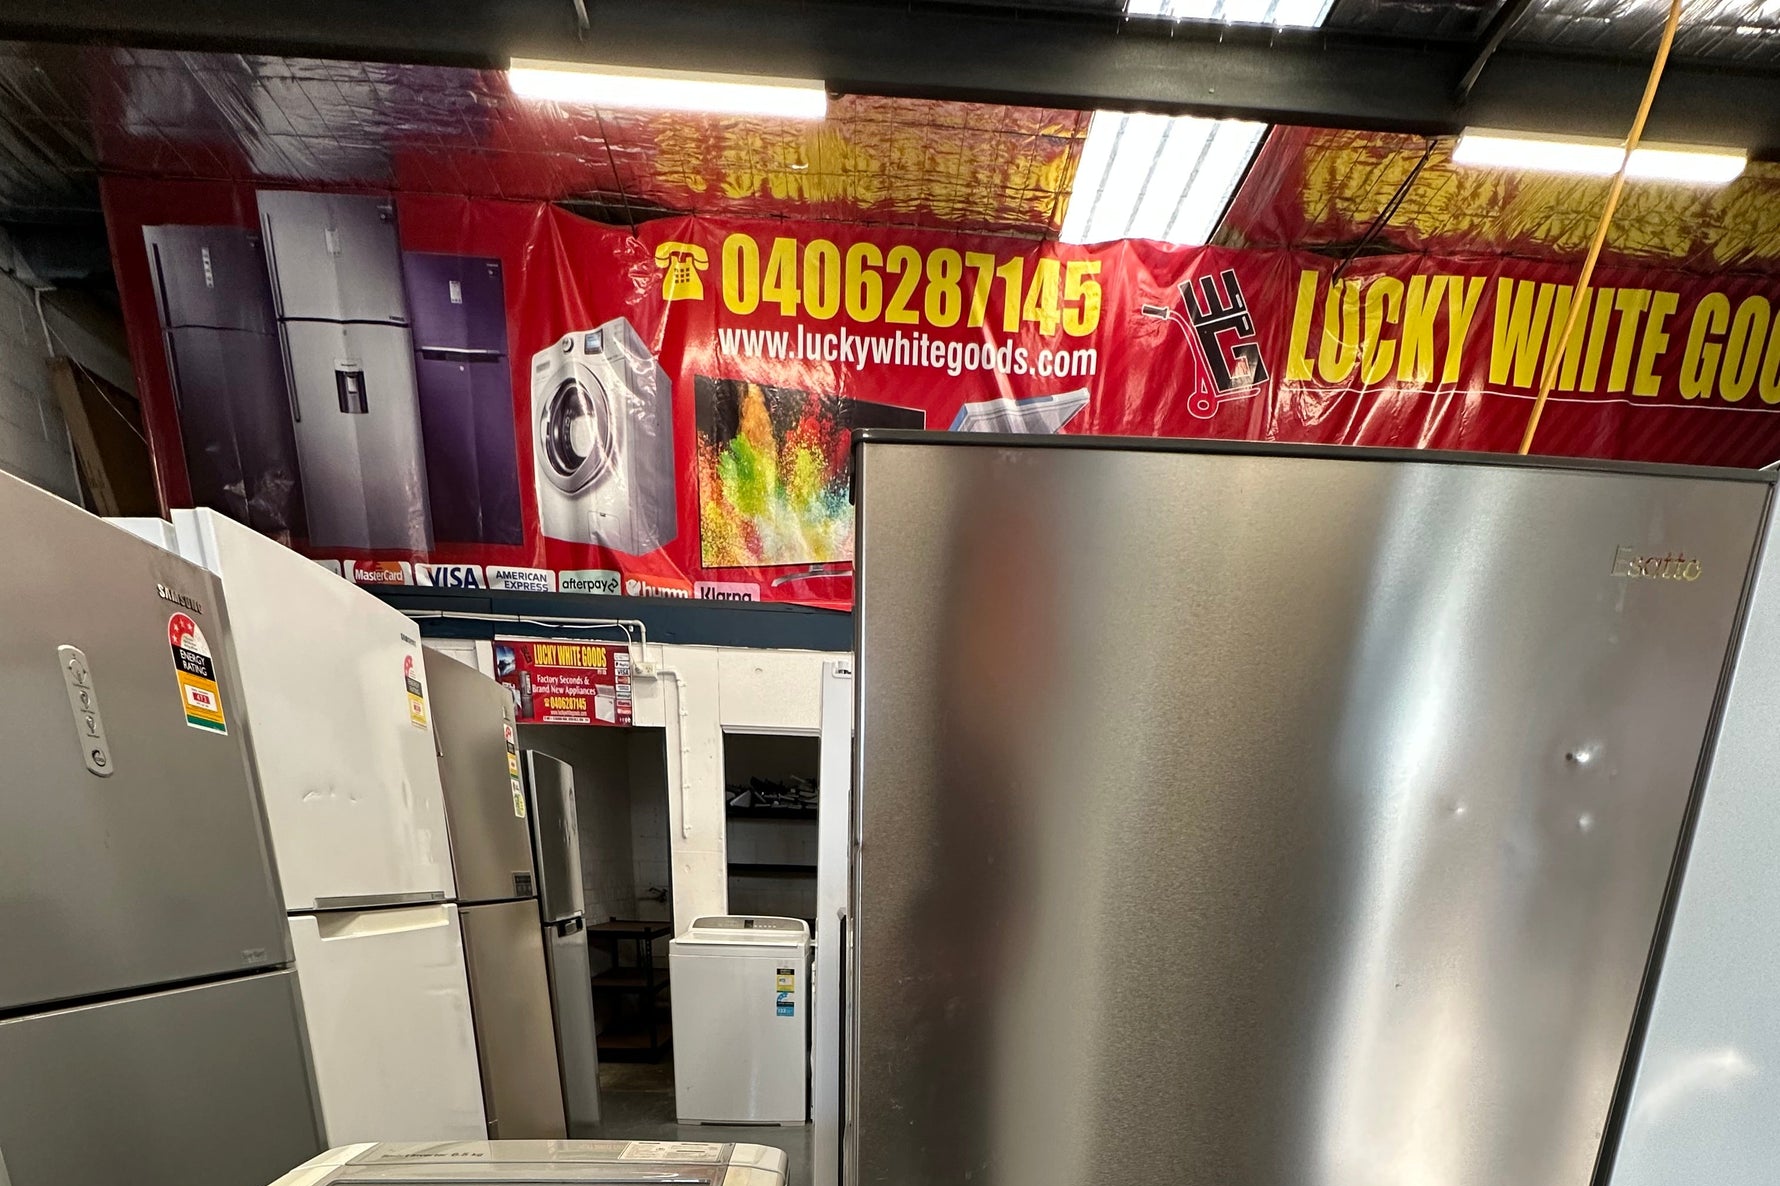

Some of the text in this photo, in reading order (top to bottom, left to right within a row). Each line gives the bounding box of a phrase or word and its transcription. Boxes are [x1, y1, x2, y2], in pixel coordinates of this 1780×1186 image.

[721, 232, 1101, 337] 0406287145
[1286, 270, 1487, 385] LUCKY
[1488, 276, 1680, 397] WHITE
[718, 323, 1097, 380] www.luckywhitegoods.com
[355, 568, 404, 582] MasterCard
[427, 566, 480, 589] VISA
[495, 570, 547, 583] AMERICAN
[504, 580, 549, 592] EXPRESS
[562, 578, 608, 592] afterpay
[641, 581, 689, 599] humm
[701, 587, 752, 602] Klarna
[179, 650, 205, 666] ENERGY
[533, 644, 607, 668] LUCKY WHITE GOODS
[182, 660, 208, 677] RATING
[537, 674, 558, 685] Factory
[560, 675, 583, 685] Seconds
[532, 684, 596, 696] Brand New Appliances
